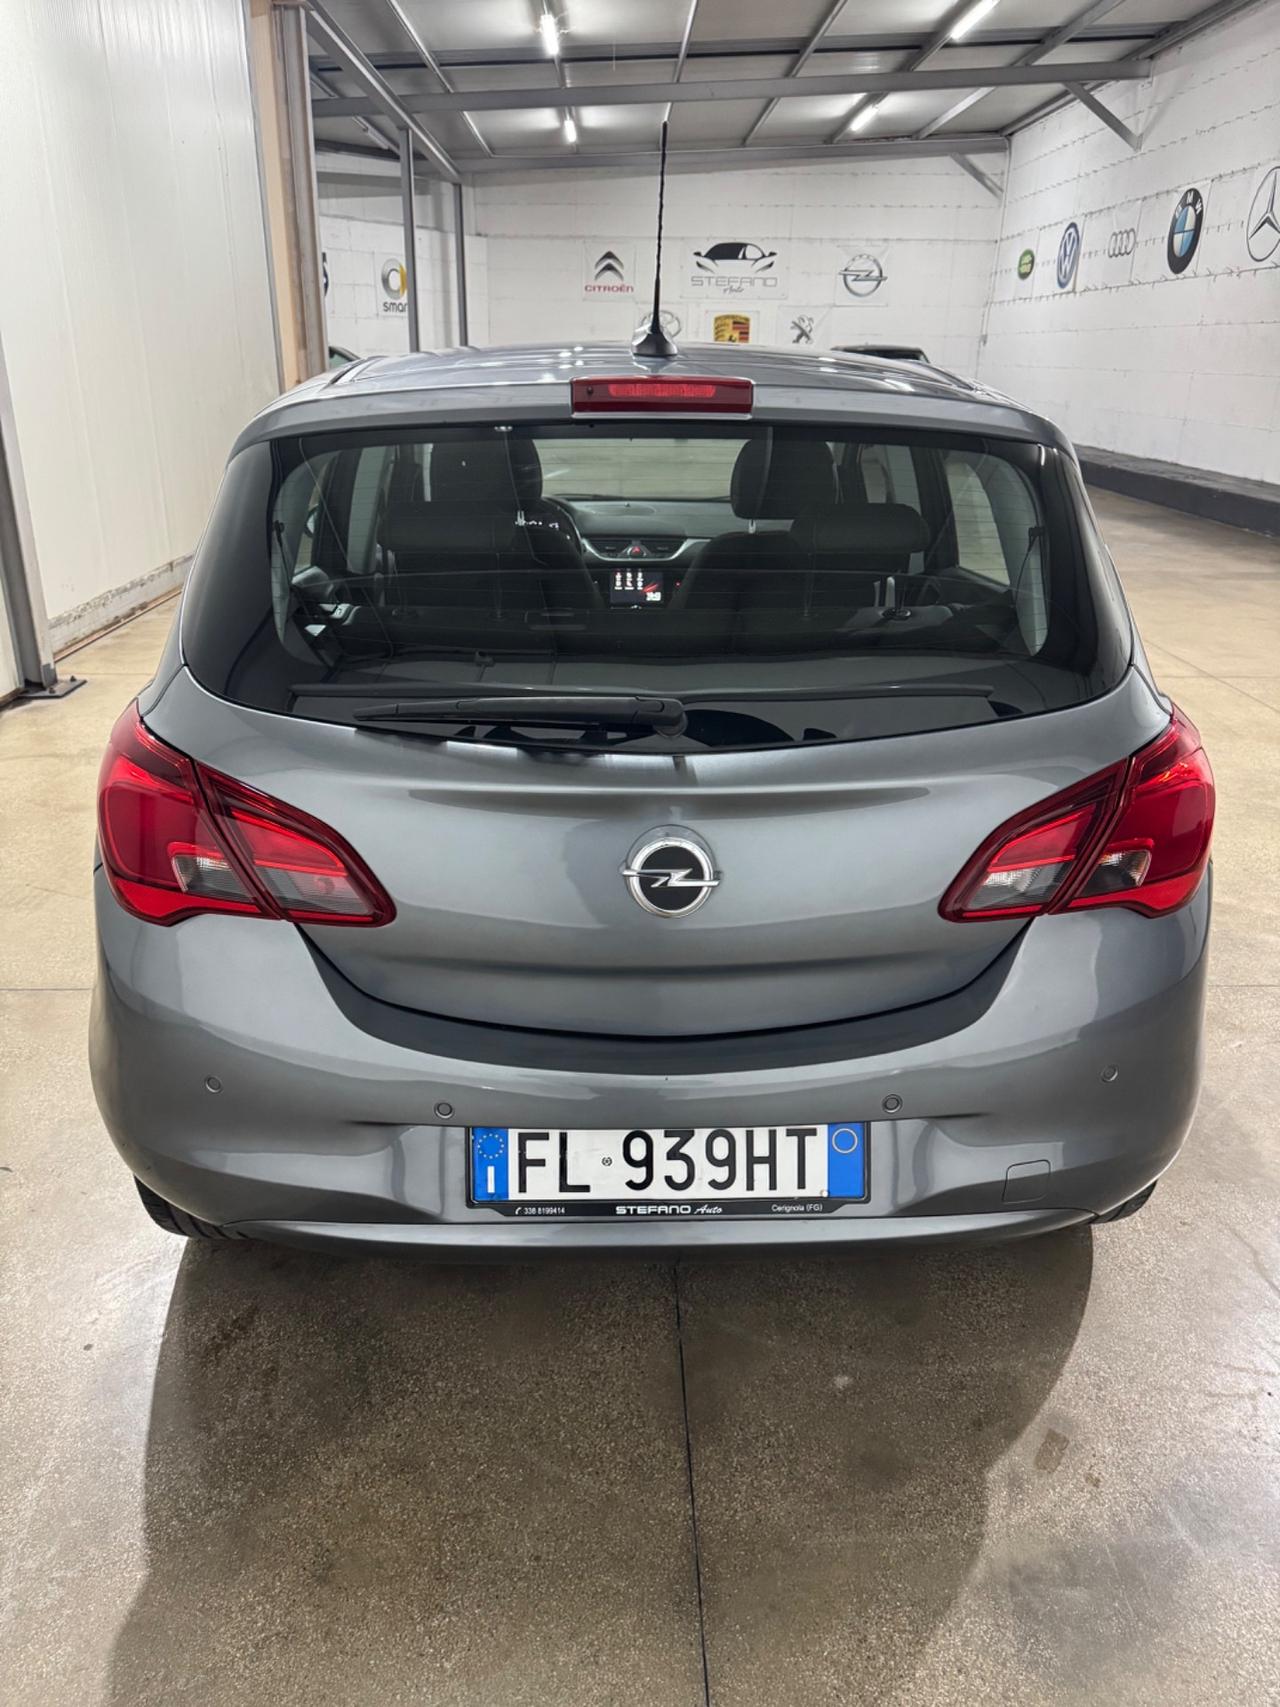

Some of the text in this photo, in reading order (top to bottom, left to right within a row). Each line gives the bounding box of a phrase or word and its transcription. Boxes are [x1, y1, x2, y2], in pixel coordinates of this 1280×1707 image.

[691, 275, 778, 288] STEFANO
[382, 301, 409, 313] smar
[518, 1128, 818, 1194] FL 939HT
[615, 1203, 723, 1216] STEFANO Auto
[771, 1202, 823, 1213] Cerignola (FG)
